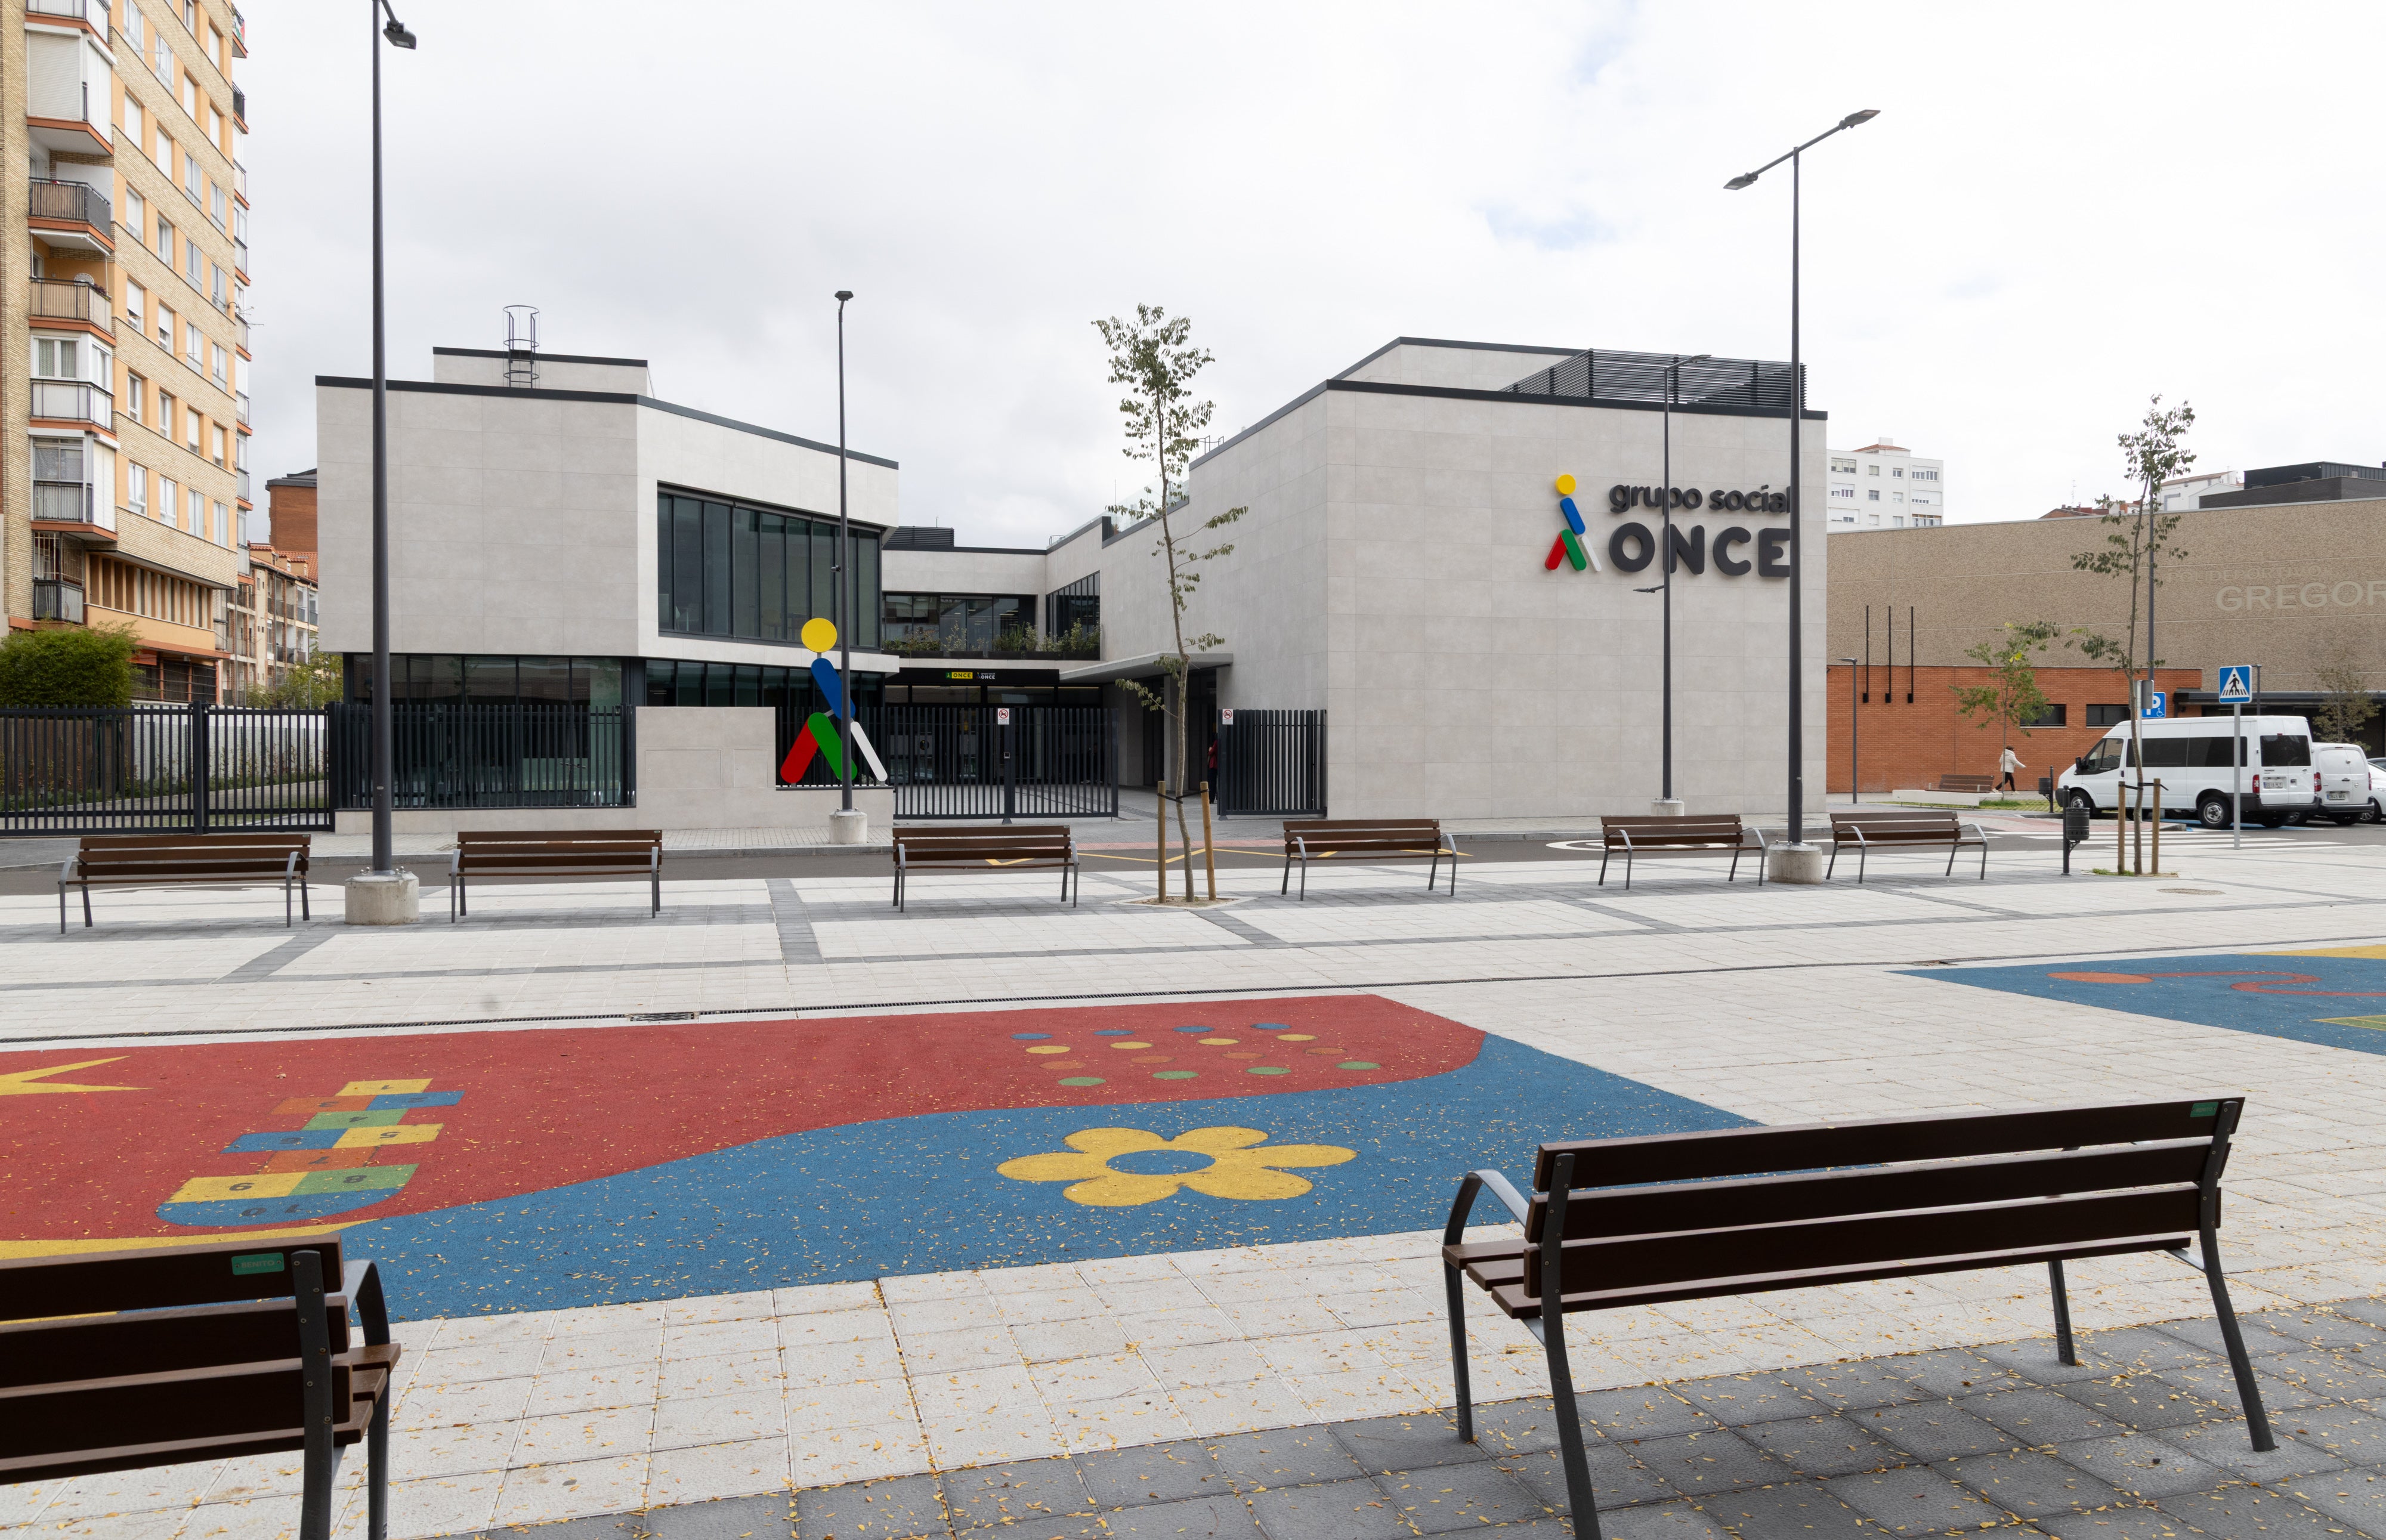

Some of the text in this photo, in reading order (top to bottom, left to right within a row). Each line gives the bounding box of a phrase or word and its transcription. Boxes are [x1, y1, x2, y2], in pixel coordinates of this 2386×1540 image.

[1609, 484, 1791, 515] grupo social
[1608, 522, 1791, 577] ONCE
